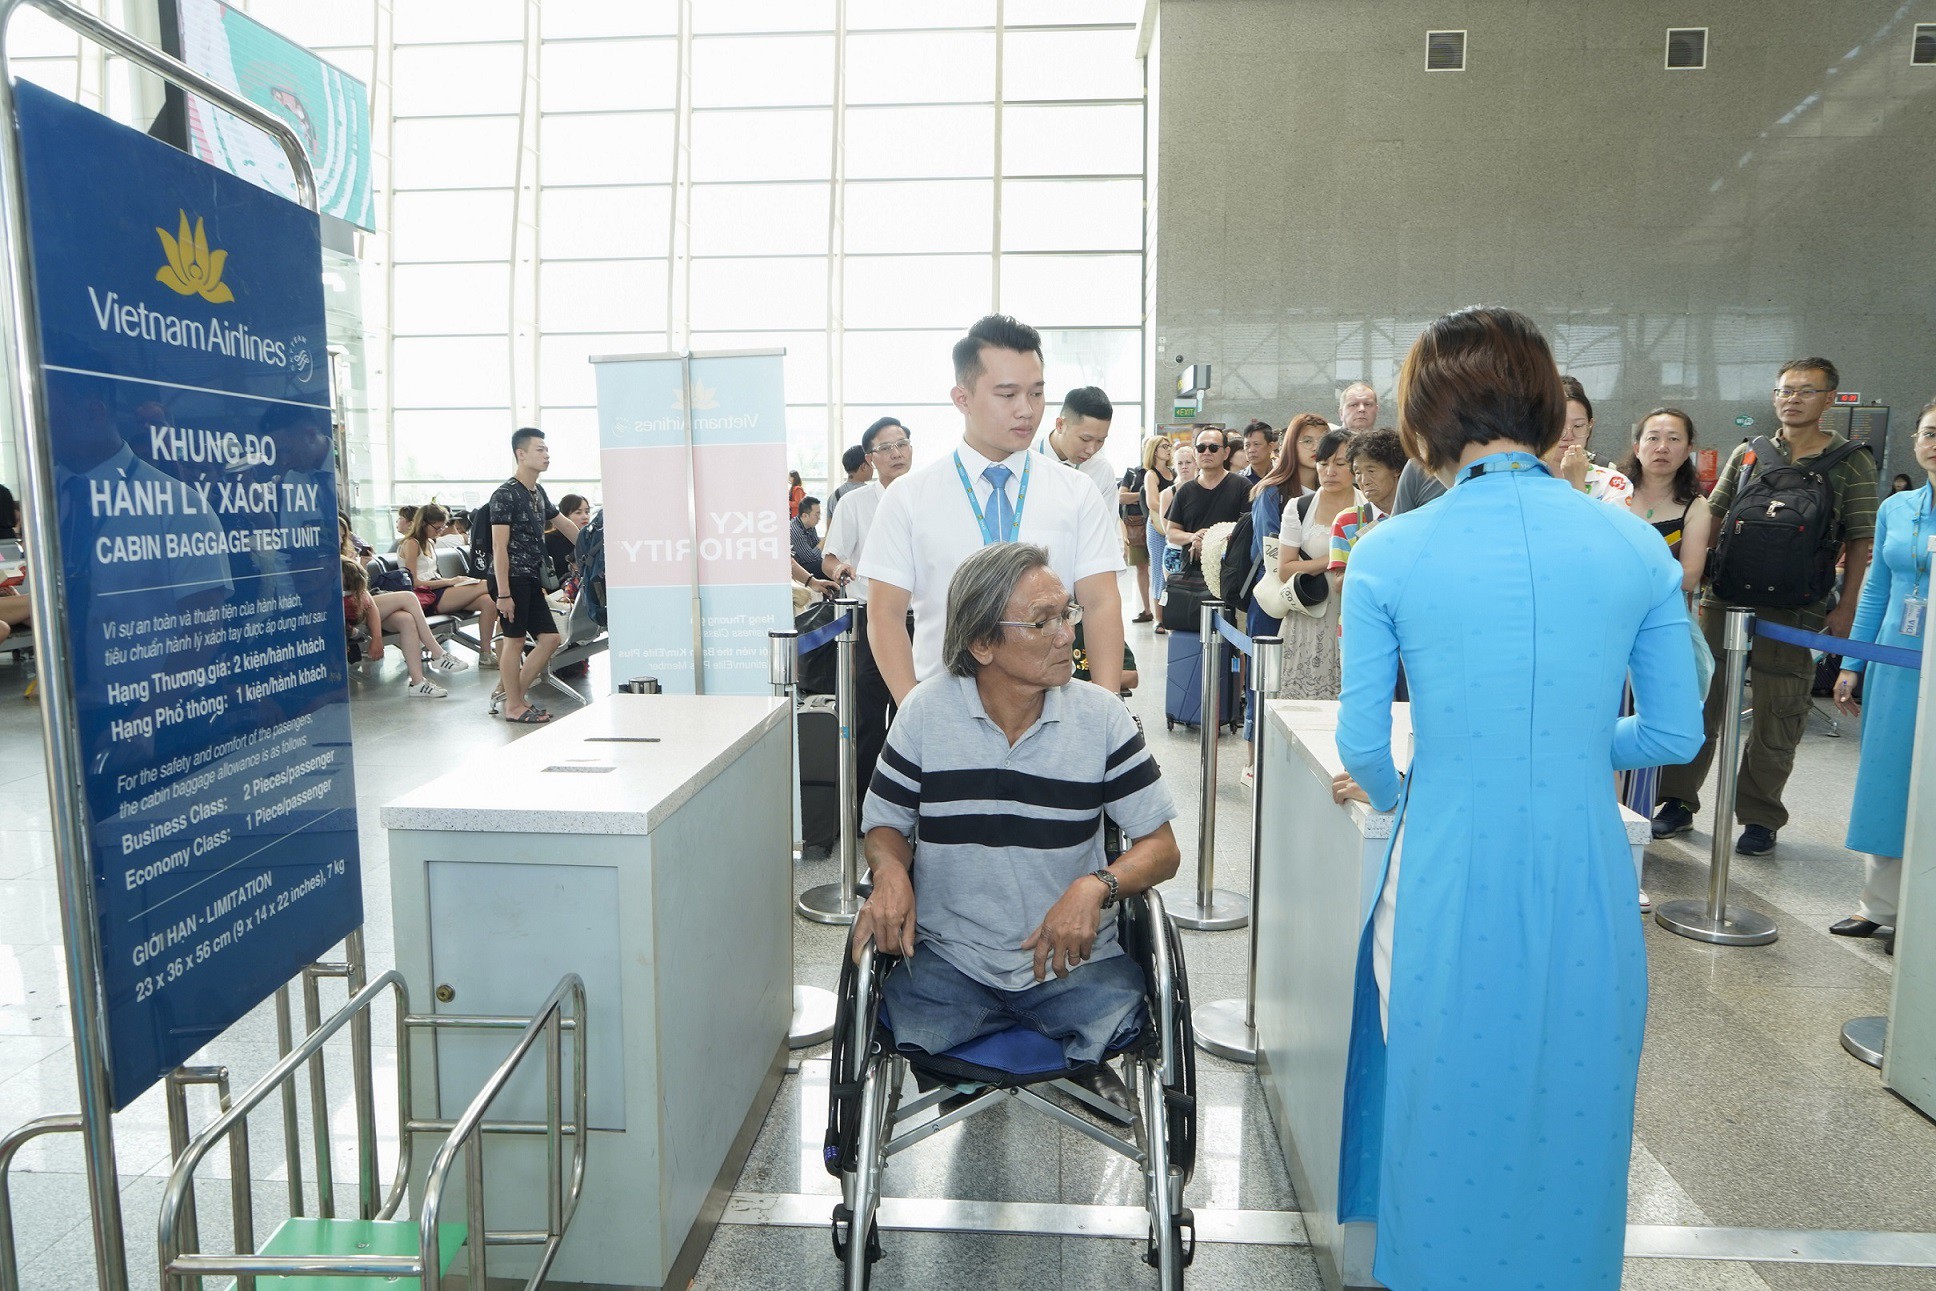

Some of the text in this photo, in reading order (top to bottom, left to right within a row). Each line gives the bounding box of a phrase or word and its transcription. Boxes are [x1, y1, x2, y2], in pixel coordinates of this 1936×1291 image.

[88, 286, 287, 367] Vietnam Airlines
[150, 425, 277, 466] KHUNG ĐO
[1180, 408, 1195, 416] EXIT
[90, 467, 318, 517] HÀNH LÝ XÁCH TAY
[96, 527, 321, 564] CABIN BAGGAGE TEST UNIT
[104, 647, 127, 666] tiêu
[129, 637, 163, 661] chuẩn
[166, 633, 192, 654] hành
[193, 631, 203, 651] lý
[204, 628, 227, 646] xách
[228, 628, 243, 643] tay
[243, 623, 264, 638] được
[265, 619, 276, 635] áp
[277, 617, 297, 632] dụng
[297, 611, 312, 626] như
[119, 621, 135, 639] sự
[136, 620, 151, 634] an
[153, 613, 177, 631] toàn
[179, 610, 192, 626] và
[194, 606, 220, 625] thuận
[222, 603, 238, 621] tiện
[240, 601, 255, 616] của
[256, 598, 277, 614] hành
[107, 680, 150, 706] Hạng
[207, 659, 231, 684] gia:
[234, 655, 242, 673] 2
[243, 643, 295, 671] kiện/hành
[296, 636, 325, 657] khách
[111, 664, 327, 742] Hạng Phổ thông: 1 kiện/hành khách
[117, 774, 138, 793] For
[140, 768, 157, 785] the
[160, 756, 191, 778] safety
[193, 745, 212, 766] and
[213, 733, 247, 758] comfort
[248, 729, 257, 746] of
[258, 727, 271, 742] the
[120, 735, 307, 819] the cabin baggage allowance is as follows
[122, 750, 335, 855] Business Class: 2 Pieces/passenger
[125, 779, 332, 890] Economy Class: 1 Piece/passenger
[132, 932, 165, 966] GIỚI
[167, 914, 197, 947] HẠN
[206, 870, 273, 923] LIMITATION
[136, 859, 345, 1003] 23 x 36 x 56 cm (9 x 14 x 22 inches), 7 kg
